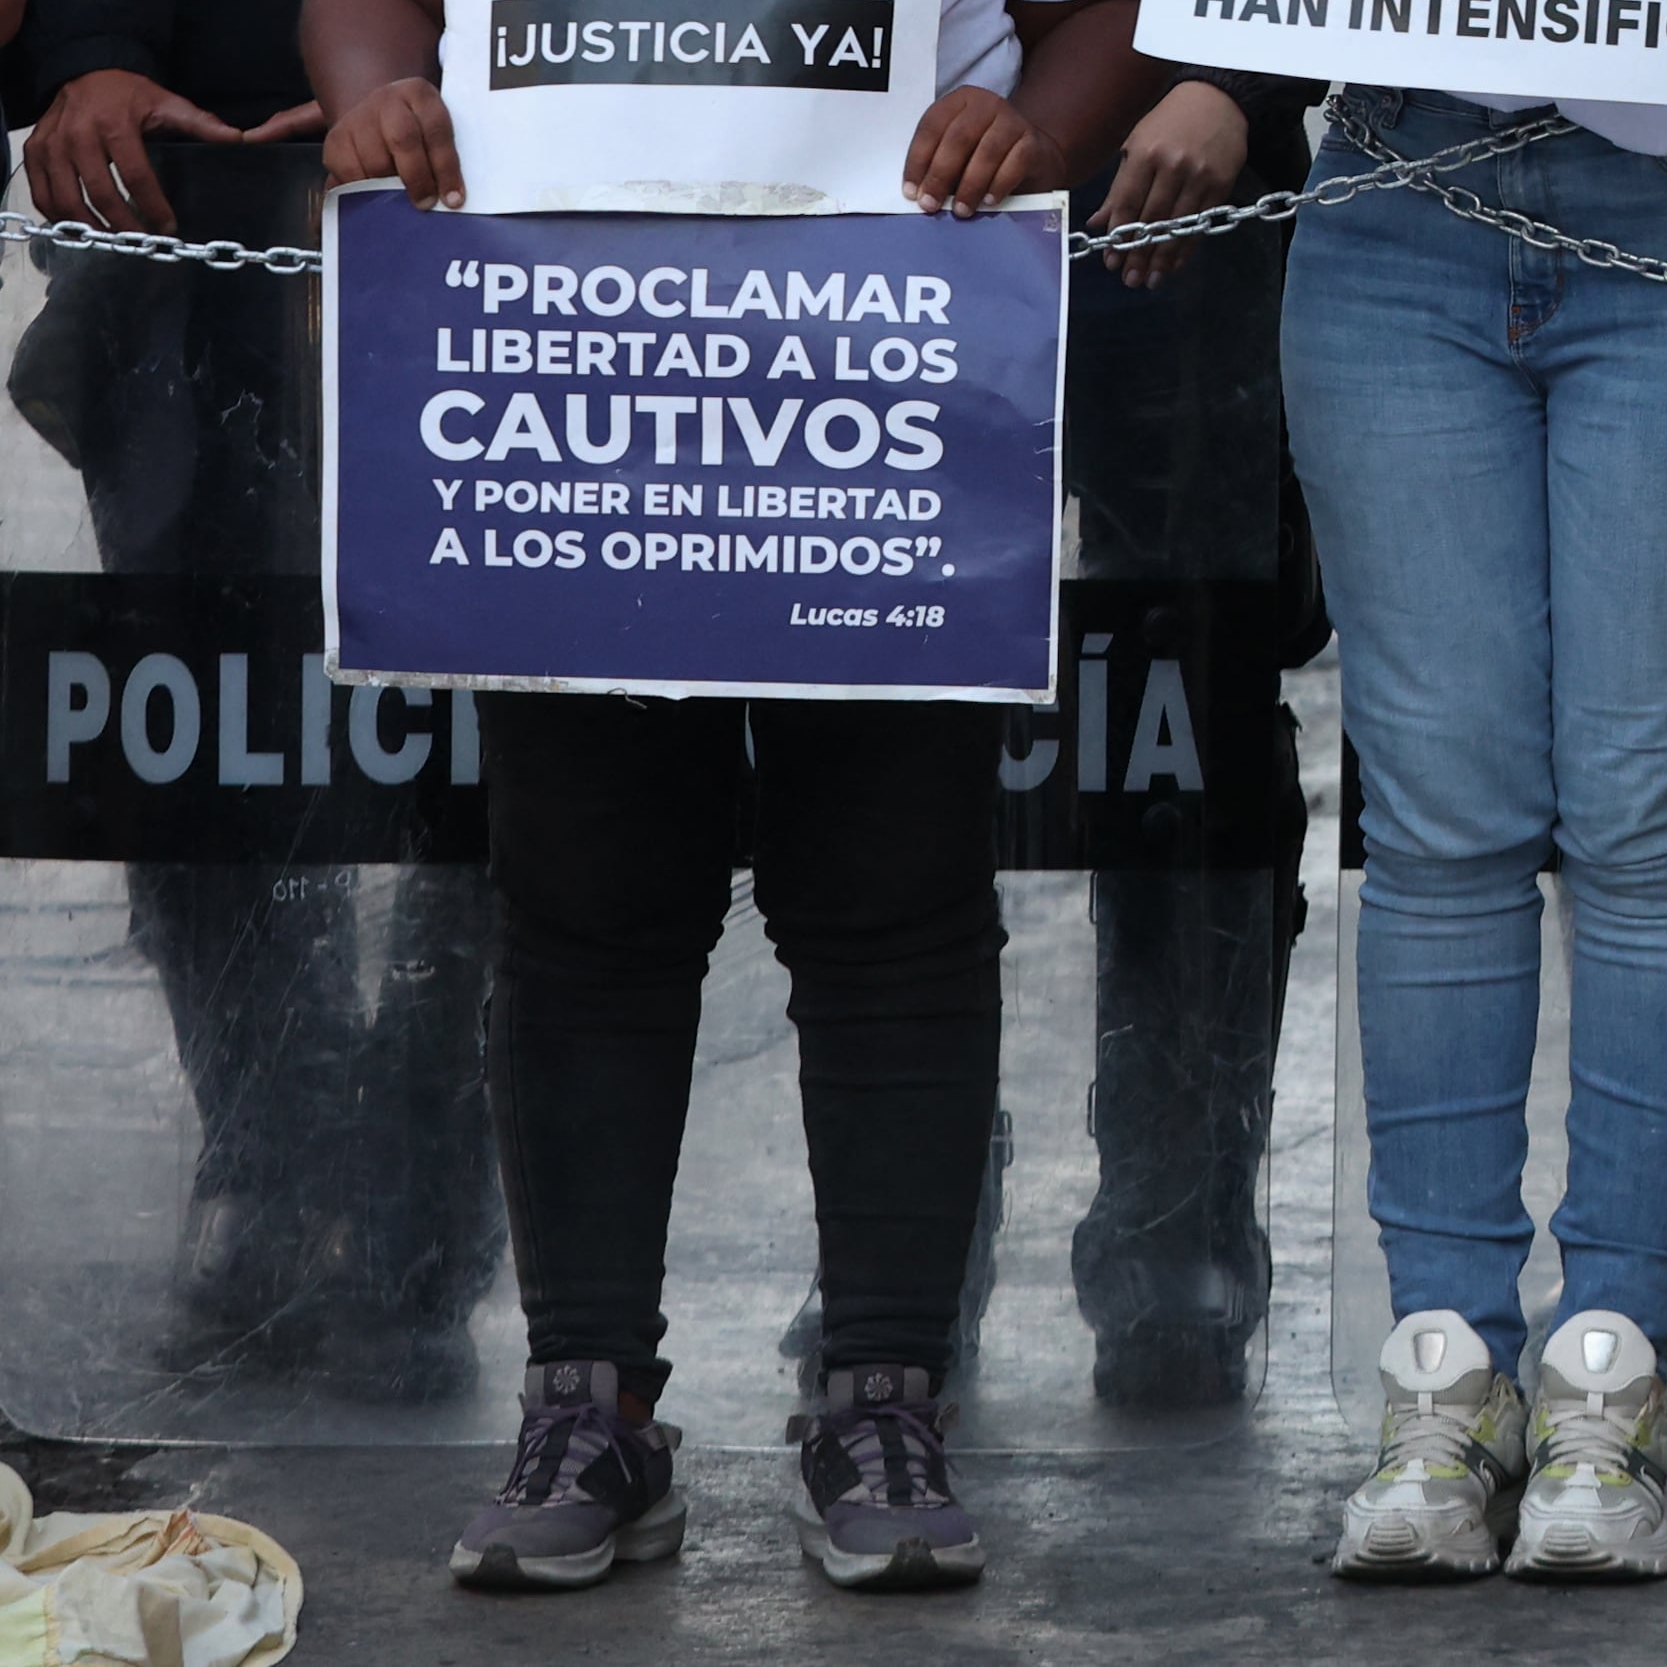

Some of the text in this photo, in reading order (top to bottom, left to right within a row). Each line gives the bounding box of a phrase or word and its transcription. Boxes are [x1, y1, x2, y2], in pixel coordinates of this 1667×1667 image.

[497, 20, 884, 68] ¡JUSTICIA YA!
[445, 259, 950, 326] “PROCLAMAR
[437, 328, 959, 385] LIBERTAD A LOS
[419, 391, 944, 471] CAUTIVOS
[433, 480, 942, 522] Y PONER EN LIBERTAD
[430, 529, 470, 565] A
[484, 529, 587, 569] LOS
[790, 601, 946, 628] Lucas 4:18
[46, 650, 481, 787] POLICI
